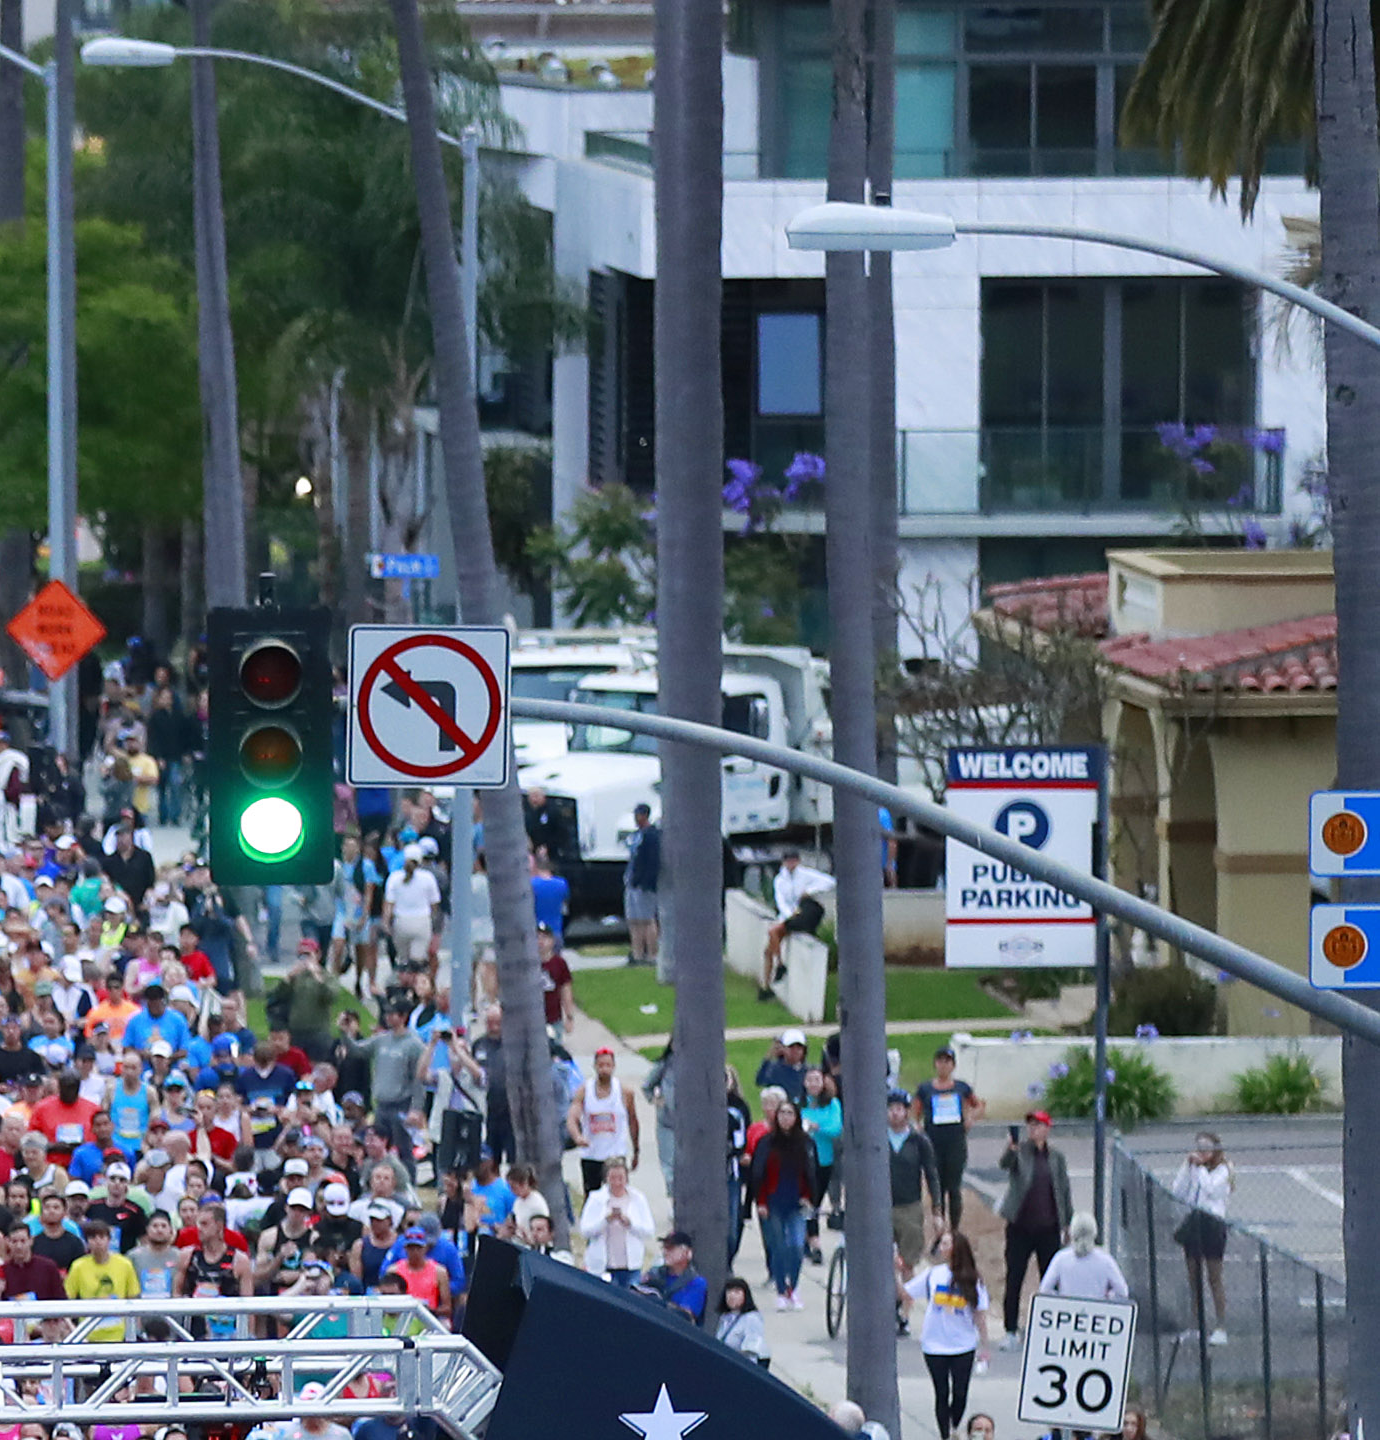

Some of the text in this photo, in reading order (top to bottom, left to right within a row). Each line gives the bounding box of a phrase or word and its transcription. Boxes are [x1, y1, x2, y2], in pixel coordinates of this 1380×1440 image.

[957, 752, 1089, 780] WELCOME
[1008, 810, 1037, 843] P
[961, 887, 1081, 909] PARKING
[1039, 1310, 1124, 1335] SPEED
[1044, 1336, 1112, 1361] LIMIT
[1032, 1364, 1113, 1413] 30
